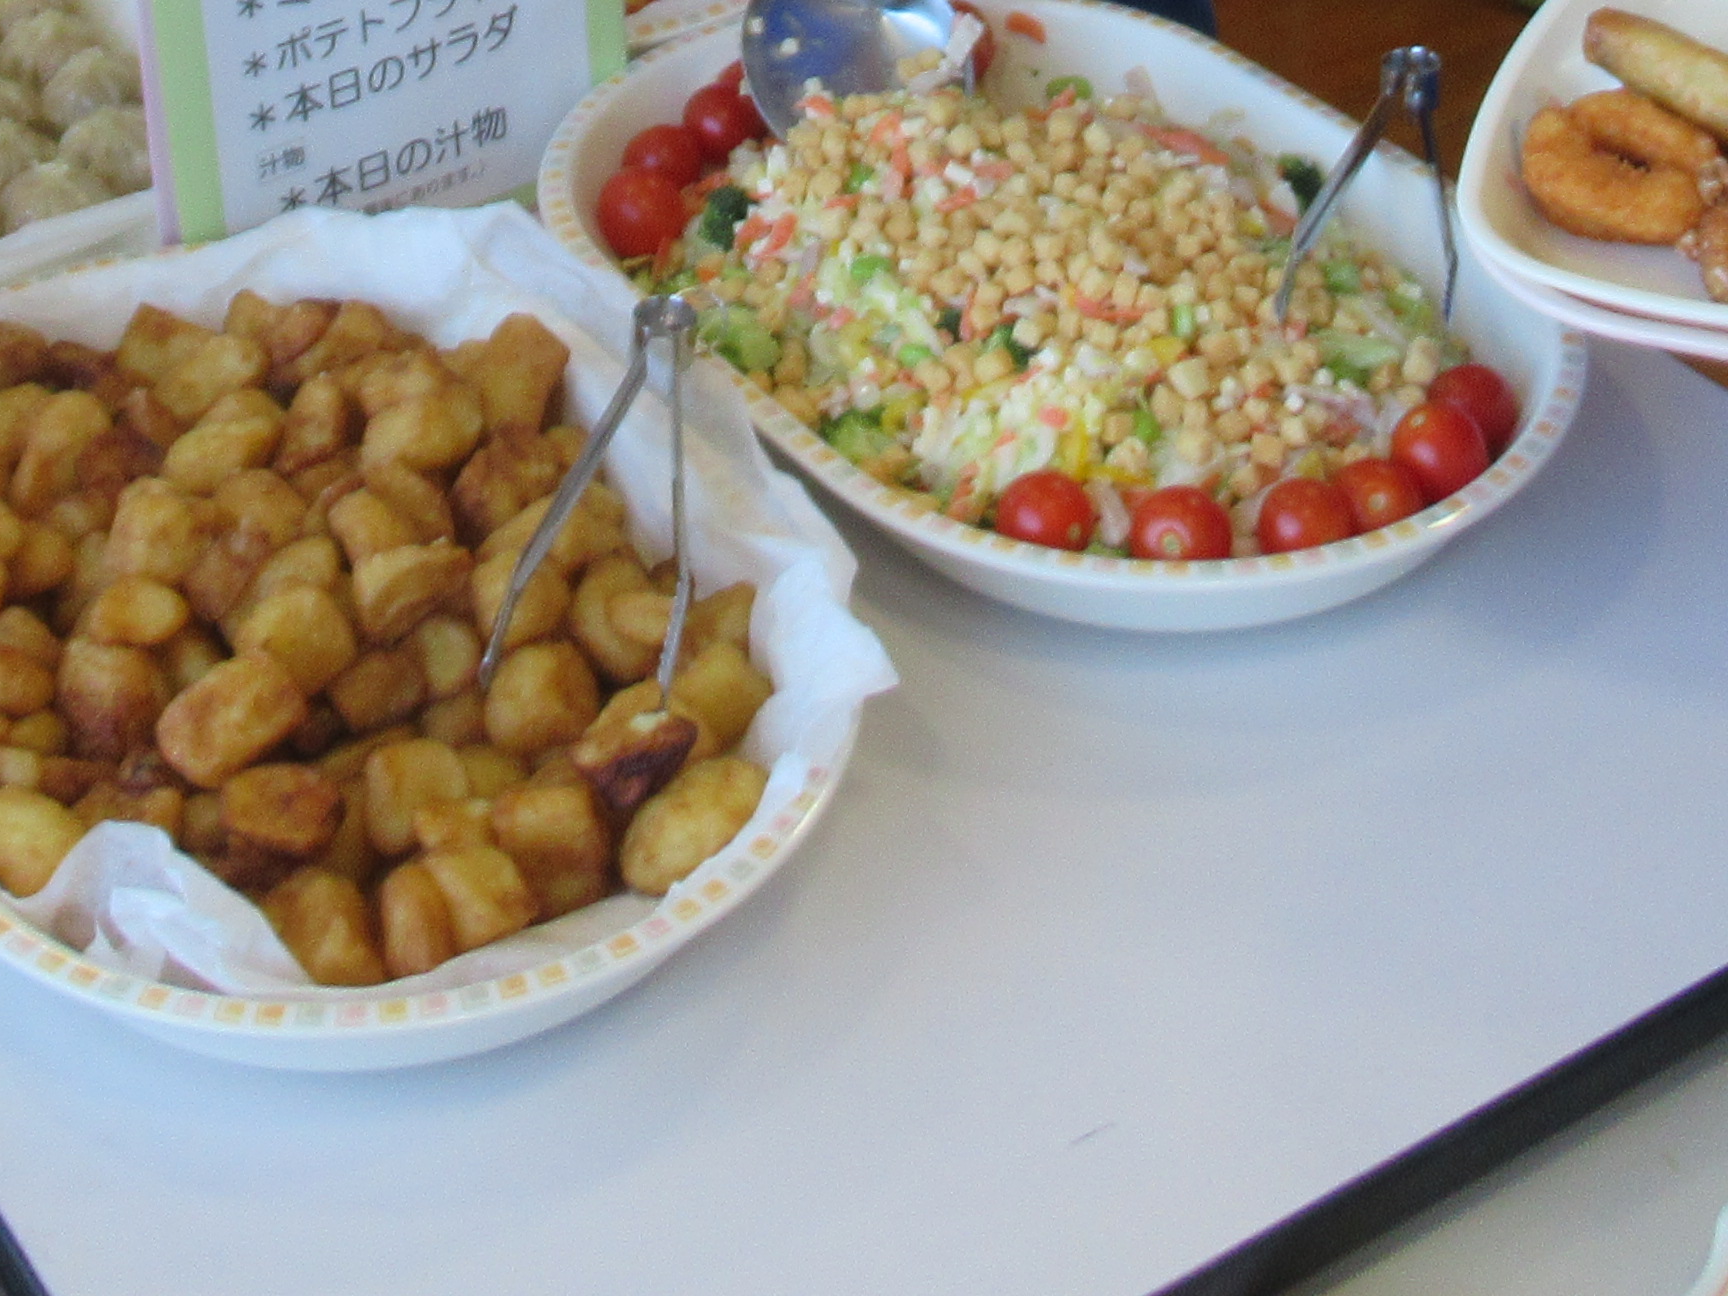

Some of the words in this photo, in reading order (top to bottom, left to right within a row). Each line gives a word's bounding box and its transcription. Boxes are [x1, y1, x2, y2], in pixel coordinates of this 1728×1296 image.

[285, 4, 518, 122] 本日のサラダ
[259, 146, 306, 178] 汁物
[314, 107, 507, 205] 本日の汁物
